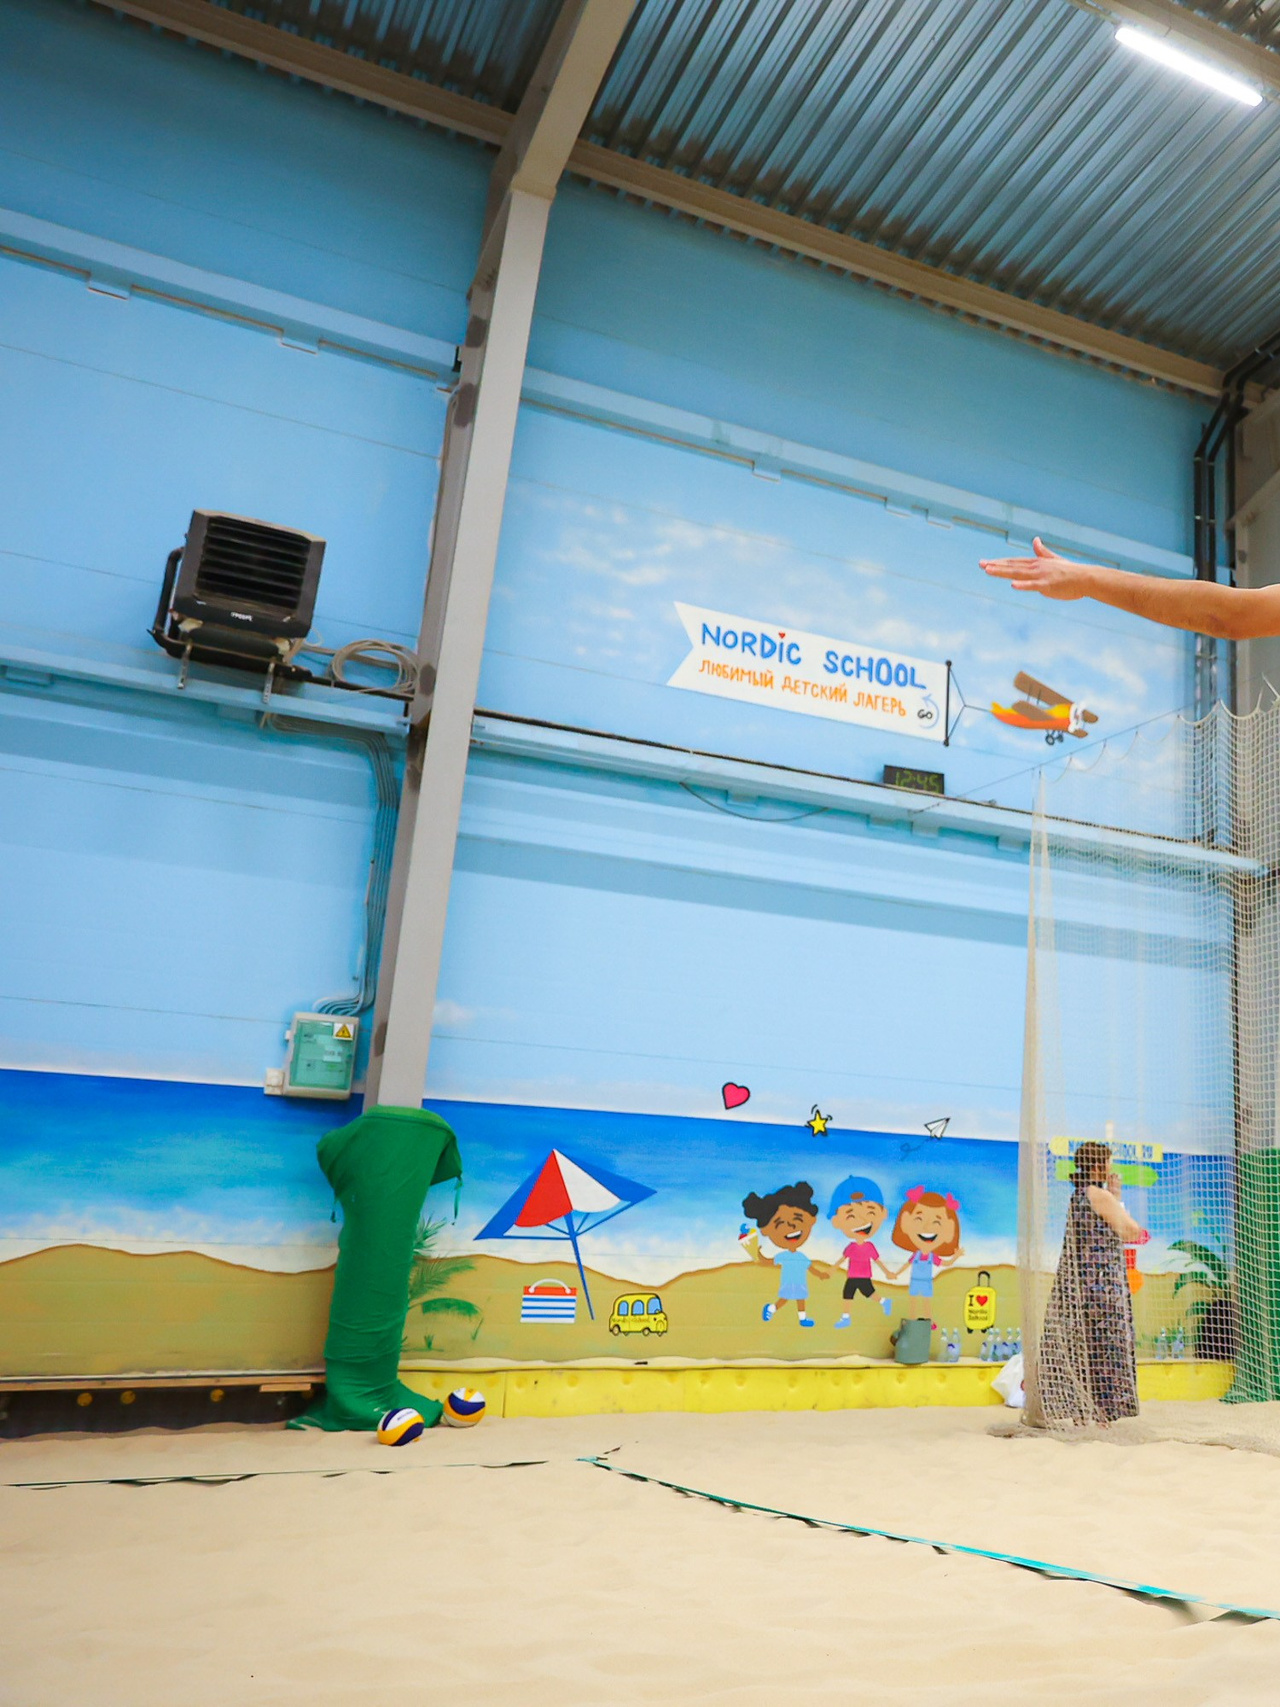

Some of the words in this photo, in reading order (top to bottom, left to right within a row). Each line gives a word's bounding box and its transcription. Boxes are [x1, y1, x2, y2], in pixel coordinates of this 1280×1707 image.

[698, 659, 774, 690] ЛЮБИМЫЙ
[782, 675, 848, 704] ДЕТСКИЙ
[853, 692, 907, 717] ЛАГЕРЬ
[823, 650, 927, 690] SCHOOL
